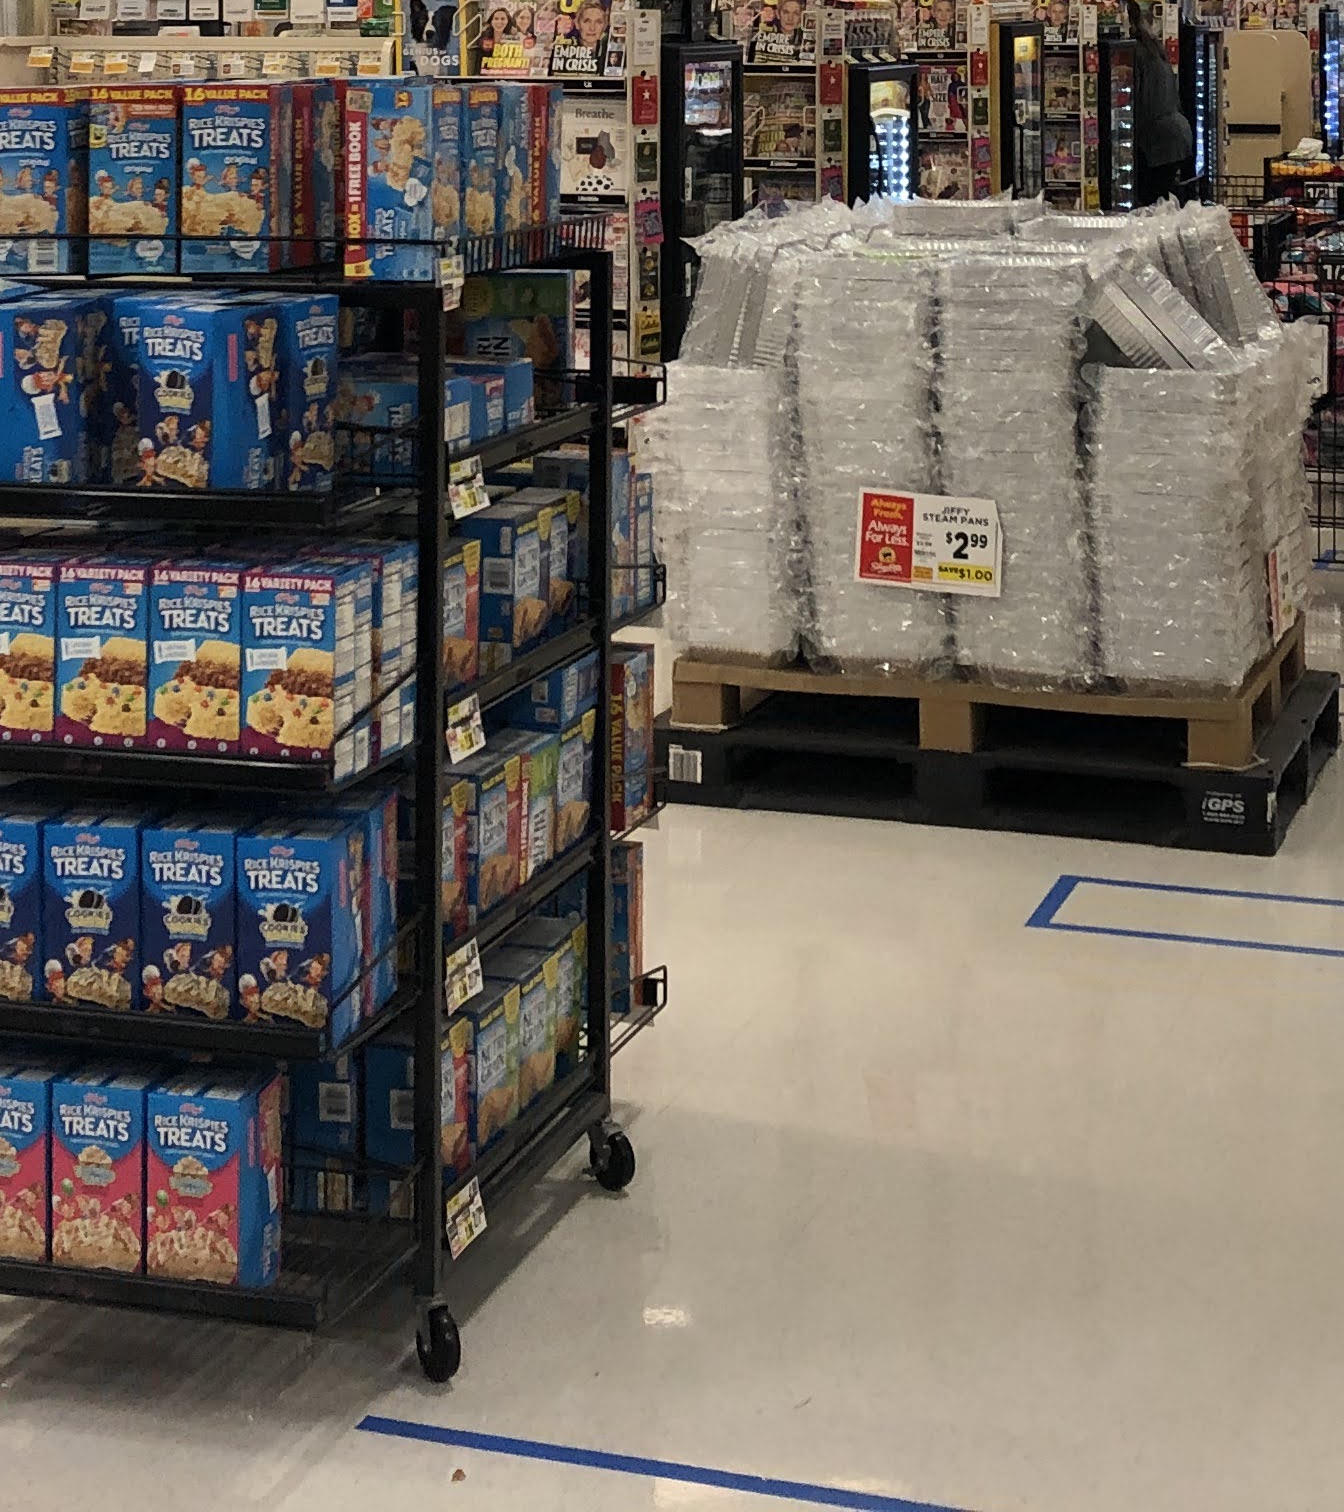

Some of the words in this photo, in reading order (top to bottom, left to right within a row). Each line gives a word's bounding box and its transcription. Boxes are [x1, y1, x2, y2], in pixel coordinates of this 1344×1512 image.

[493, 44, 523, 58] BOTH
[554, 45, 592, 60] EMPIRE
[421, 55, 459, 67] DOGS
[553, 59, 565, 71] IN
[566, 58, 598, 72] CRISIS
[90, 88, 108, 101] 16
[184, 88, 205, 101] 16
[575, 108, 615, 119] Breathe
[191, 128, 263, 149] TREATS
[348, 121, 361, 161] BOOK
[348, 163, 361, 195] FREE
[942, 506, 971, 516] JIFFY
[868, 520, 907, 535] Always
[923, 513, 957, 524] STEAM
[961, 516, 989, 527] PANS
[865, 531, 883, 544] For
[958, 568, 993, 582] $1.00
[67, 608, 135, 629] TREATS
[161, 610, 229, 632] TREATS
[253, 617, 322, 639] TREATS
[611, 718, 623, 761] VALUE
[54, 857, 123, 879] TREATS
[152, 863, 221, 886] TREATS
[247, 871, 319, 893] TREATS
[155, 1115, 178, 1127] RICE
[179, 1114, 228, 1134] KRISPIES
[157, 1128, 226, 1152] TREATS
